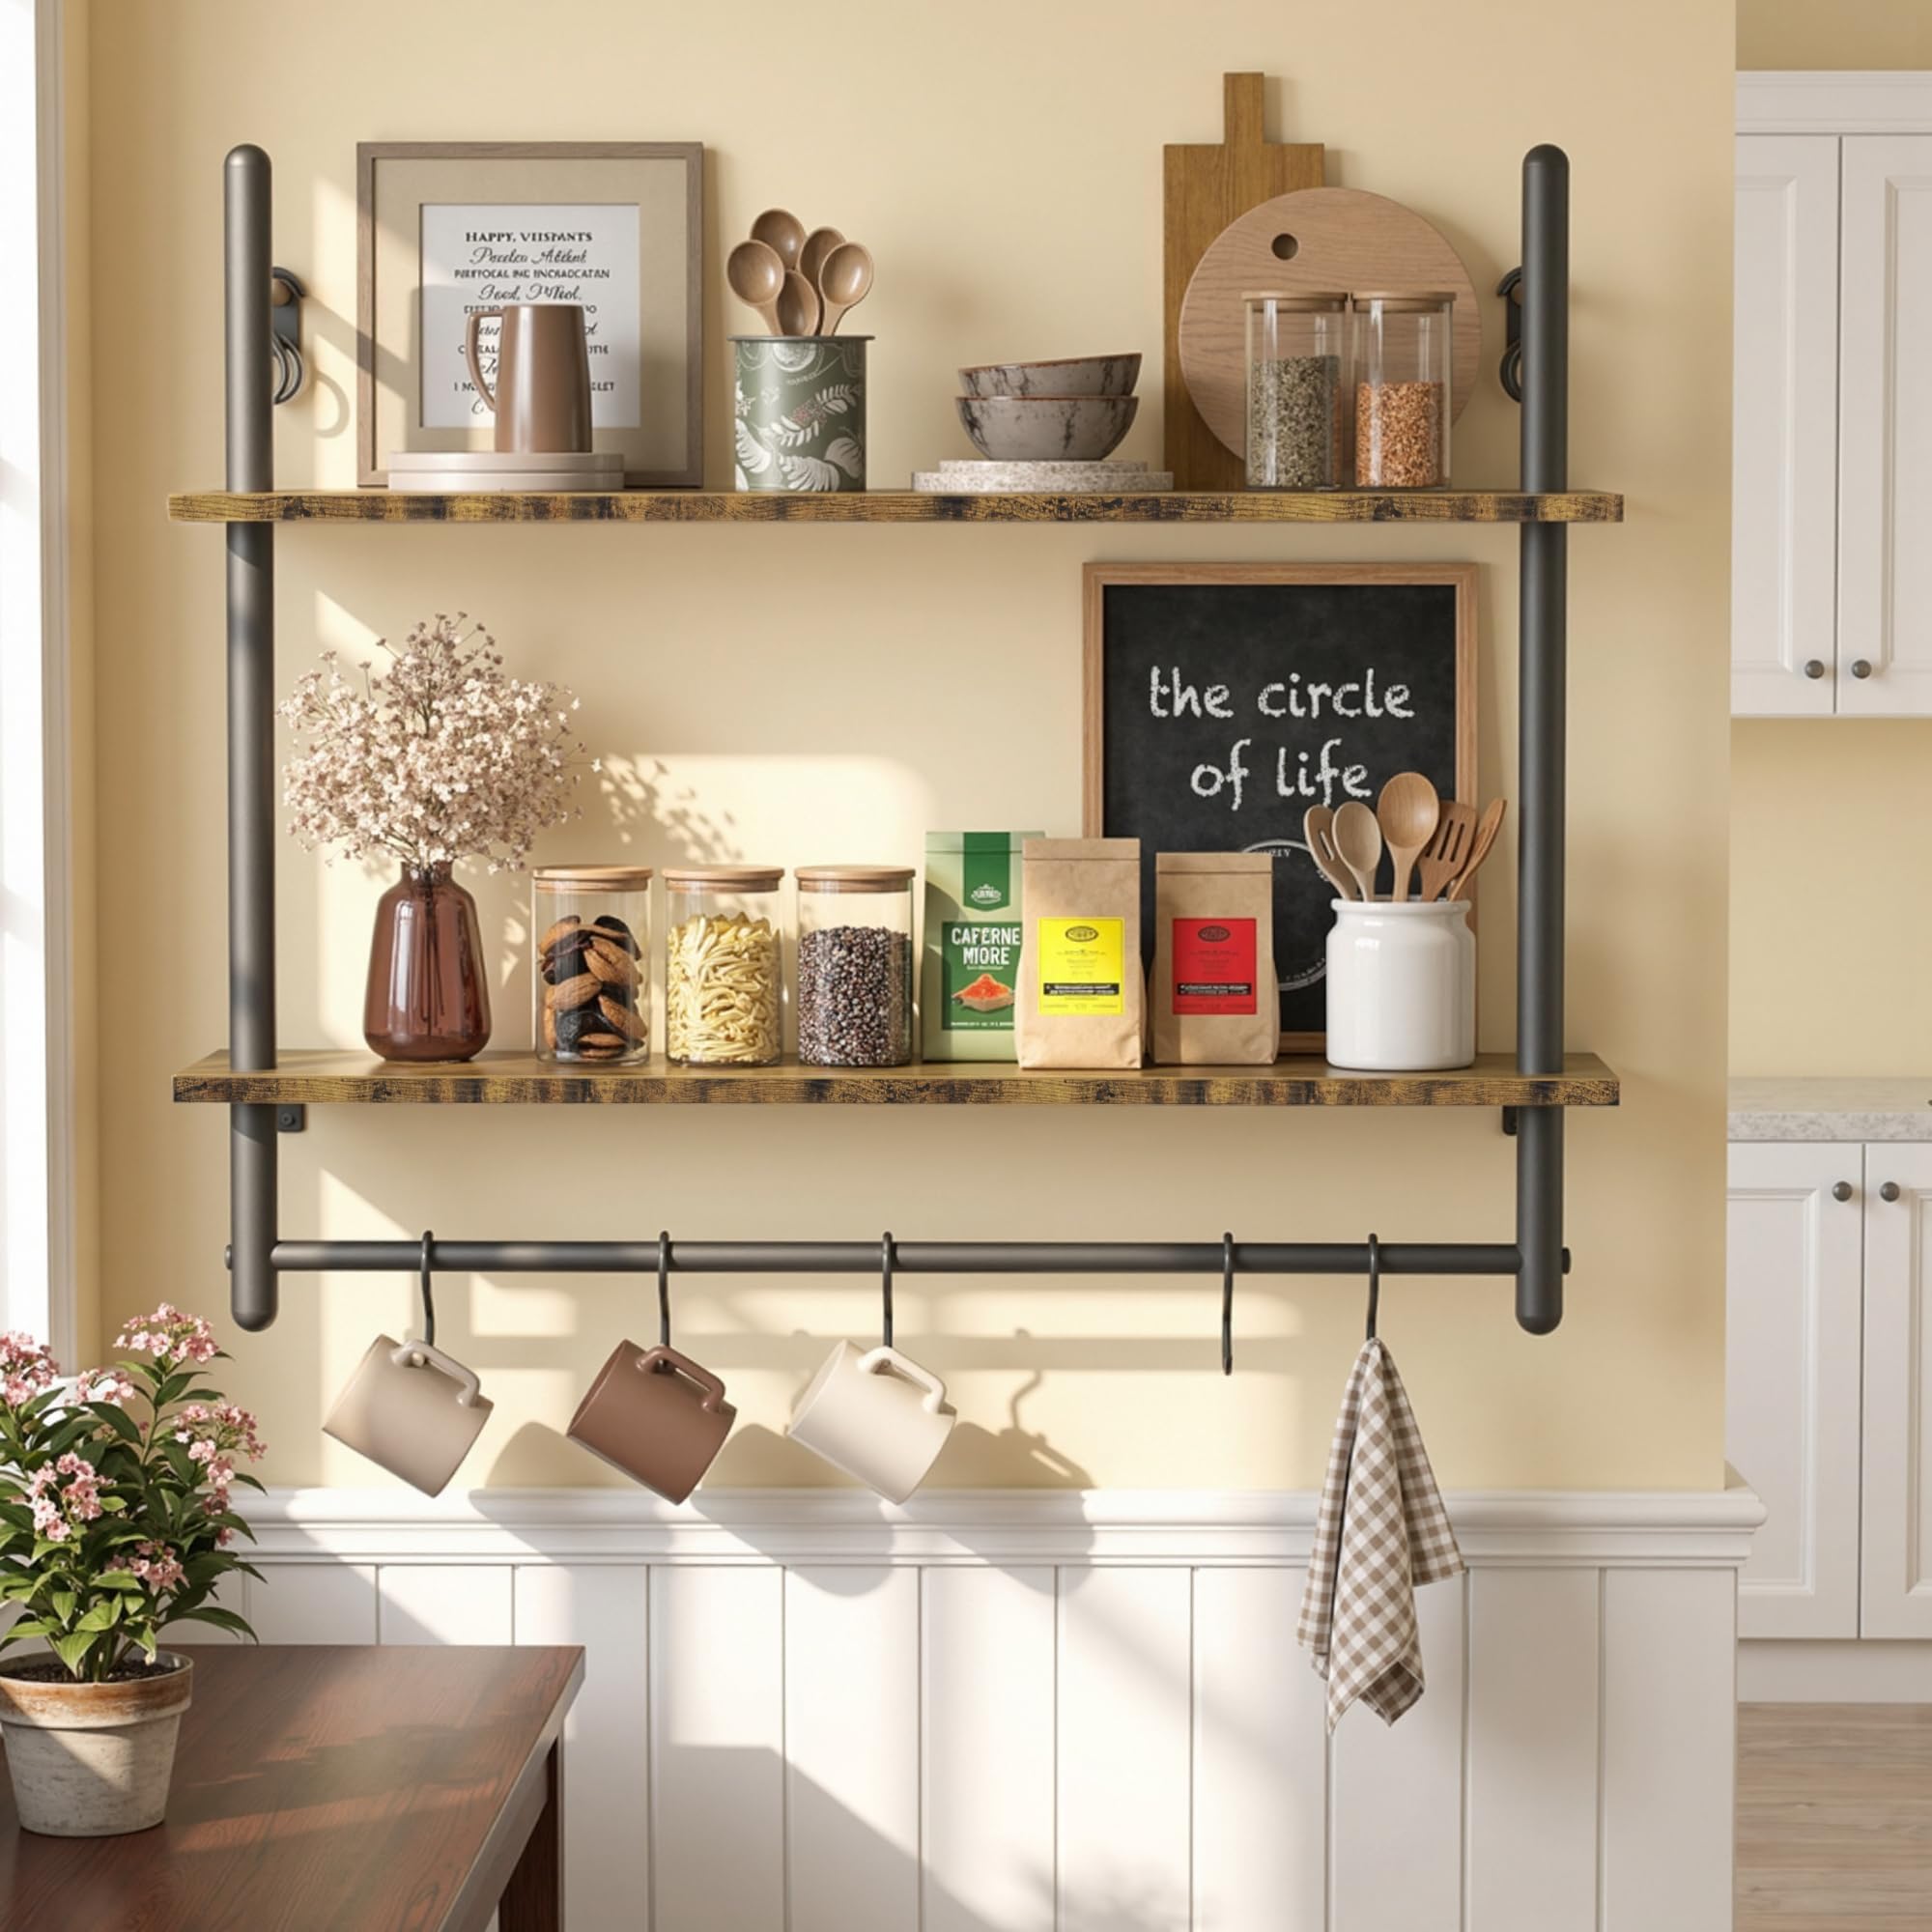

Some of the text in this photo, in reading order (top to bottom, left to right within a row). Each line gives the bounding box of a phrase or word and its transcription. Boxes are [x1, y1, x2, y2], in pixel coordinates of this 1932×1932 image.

[465, 232, 517, 242] HAPPY,
[1151, 666, 1415, 719] the circle
[1190, 738, 1372, 810] of life
